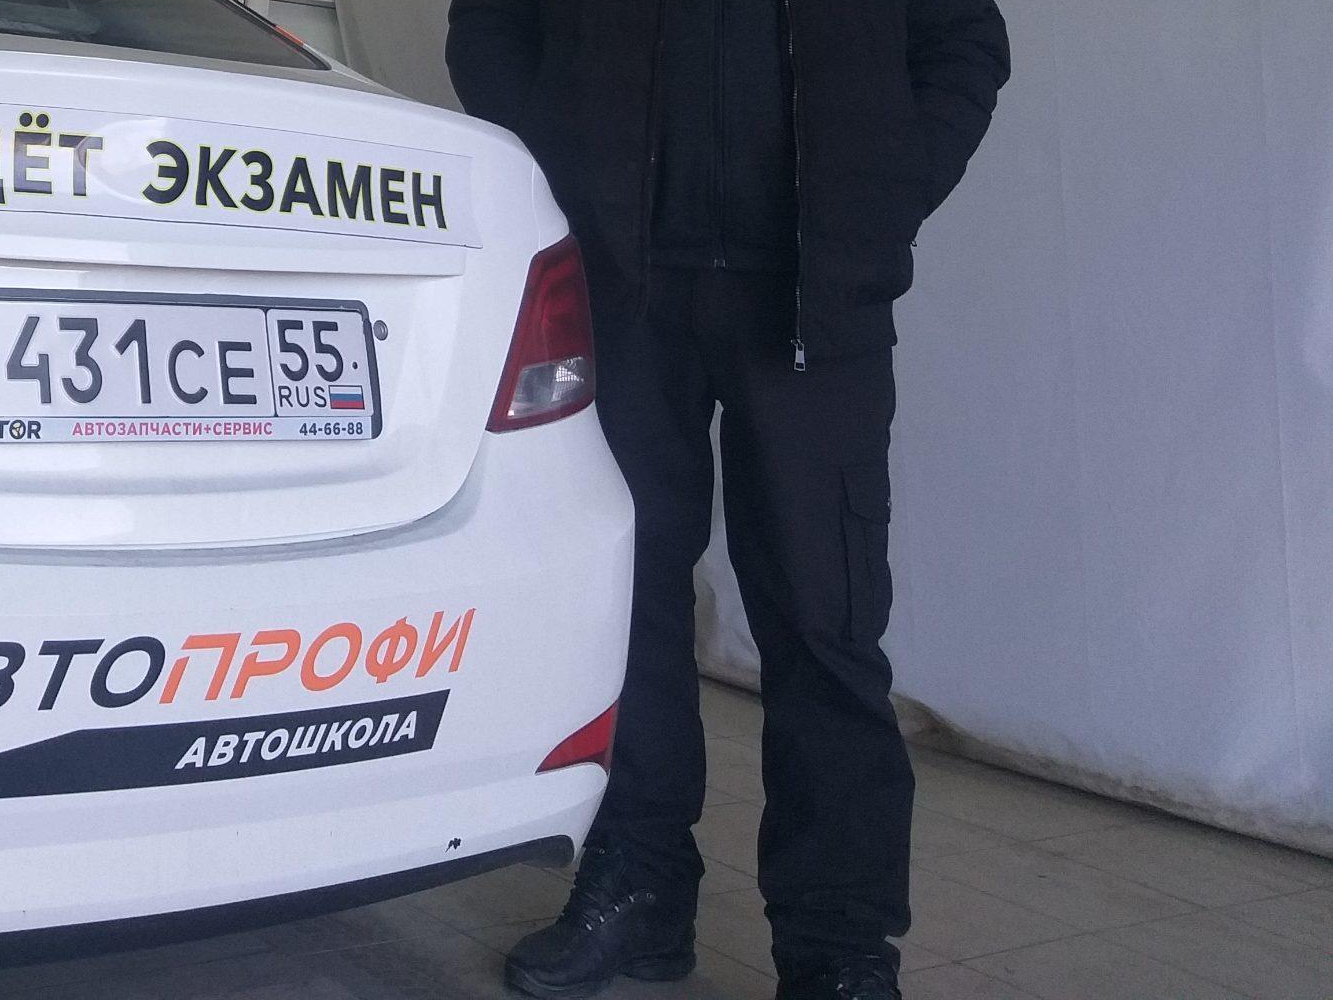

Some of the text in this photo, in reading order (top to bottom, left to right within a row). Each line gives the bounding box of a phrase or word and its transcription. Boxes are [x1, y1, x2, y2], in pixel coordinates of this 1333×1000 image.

[141, 139, 448, 231] ЭКЗАМЕН
[277, 319, 344, 382] 55
[278, 385, 327, 408] RUS
[71, 421, 273, 437] АВТОЗАПЧАСТИ+СЕРВИС
[299, 421, 364, 437] 44-66-88
[174, 709, 418, 770] АВТОШКОЛА
